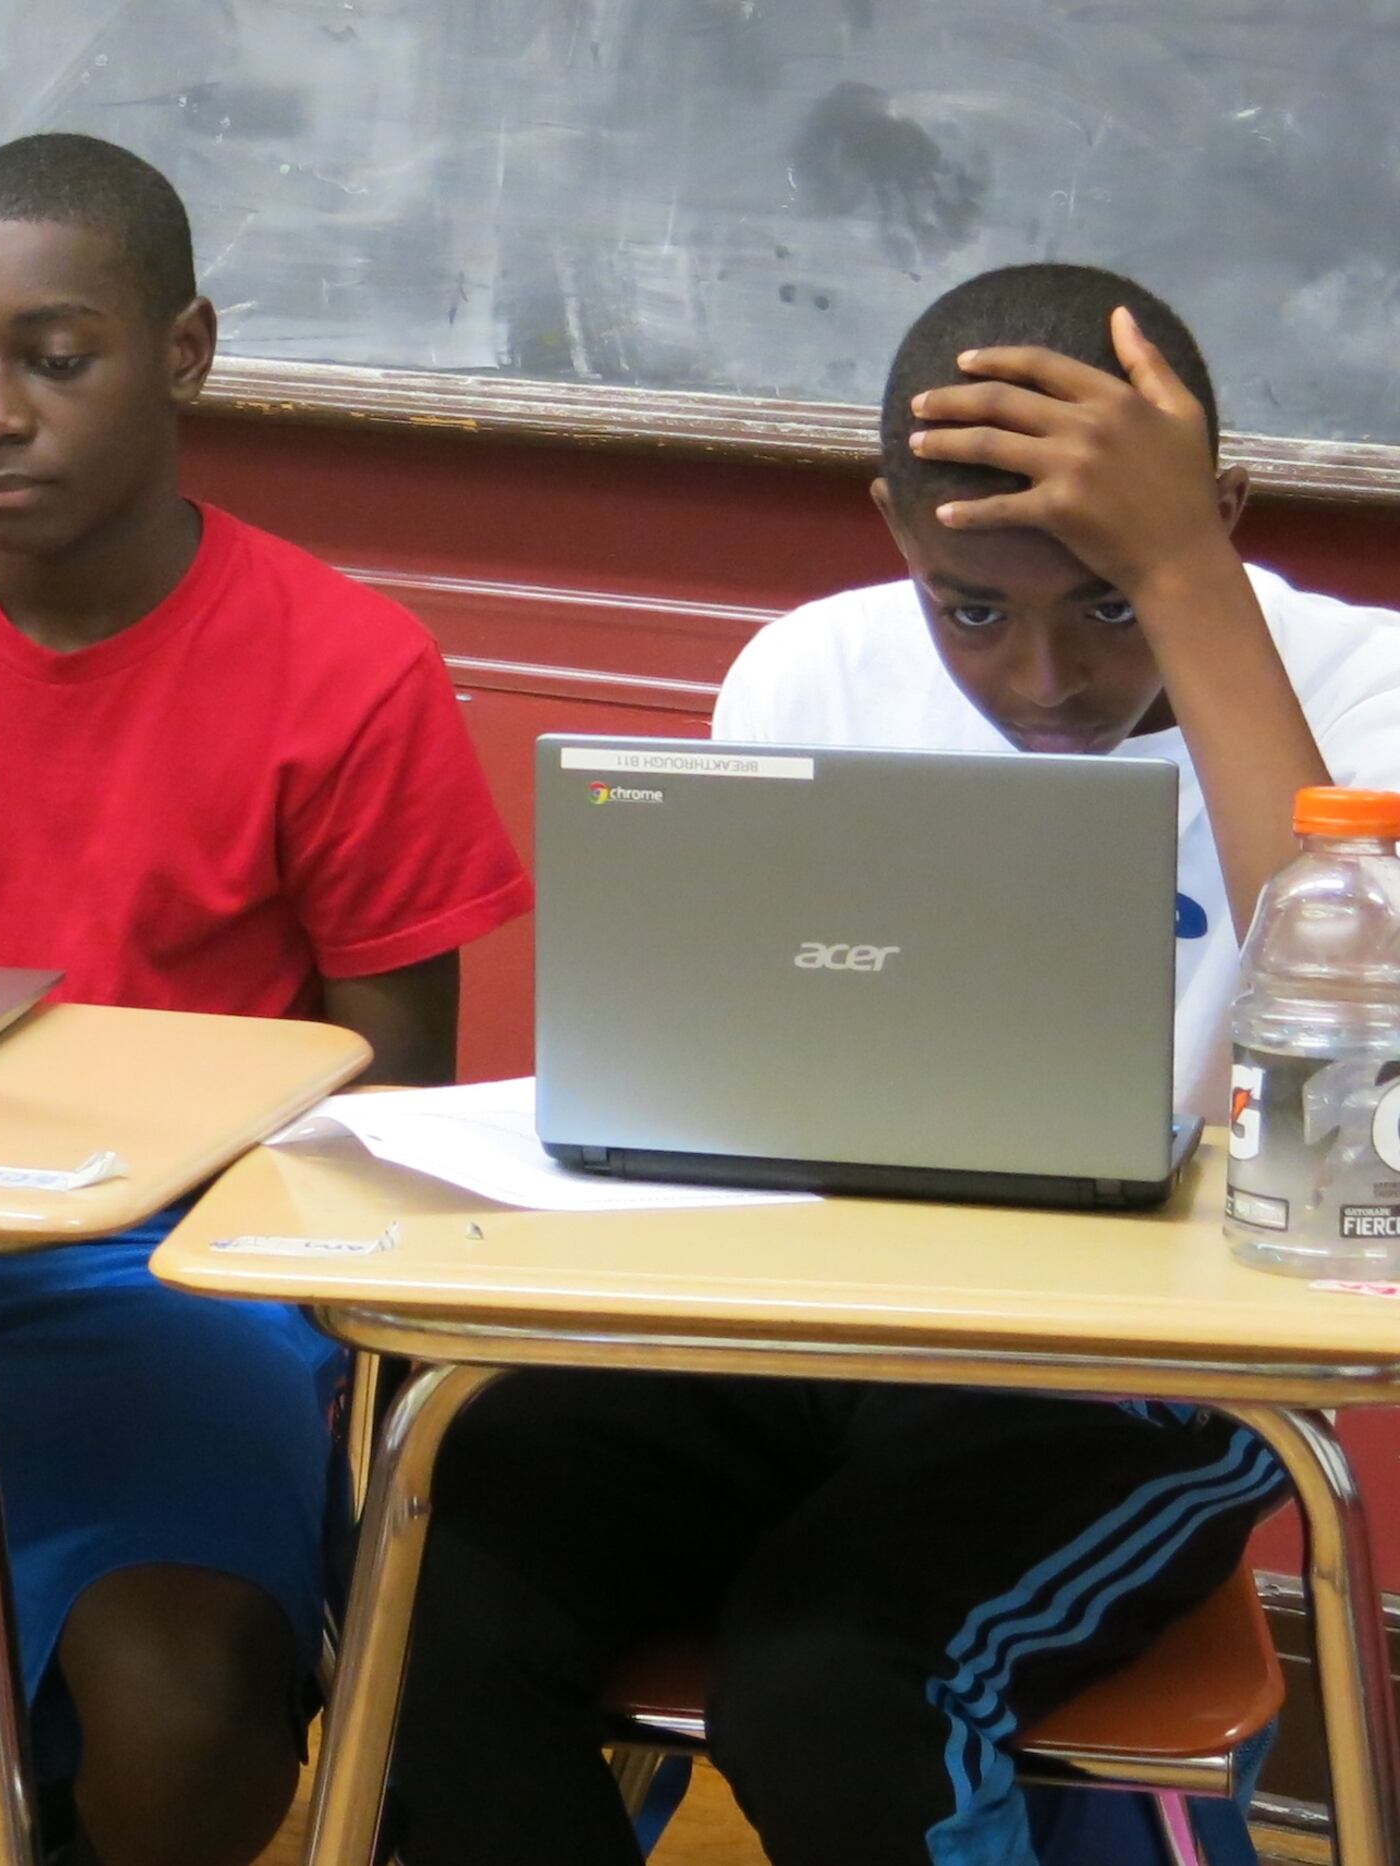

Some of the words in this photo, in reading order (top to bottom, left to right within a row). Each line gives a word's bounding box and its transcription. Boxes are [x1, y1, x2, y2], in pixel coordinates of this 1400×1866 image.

[615, 754, 640, 768] B11
[643, 757, 759, 773] BREAKTHROUGH
[610, 785, 664, 802] chrome
[793, 942, 901, 972] acer
